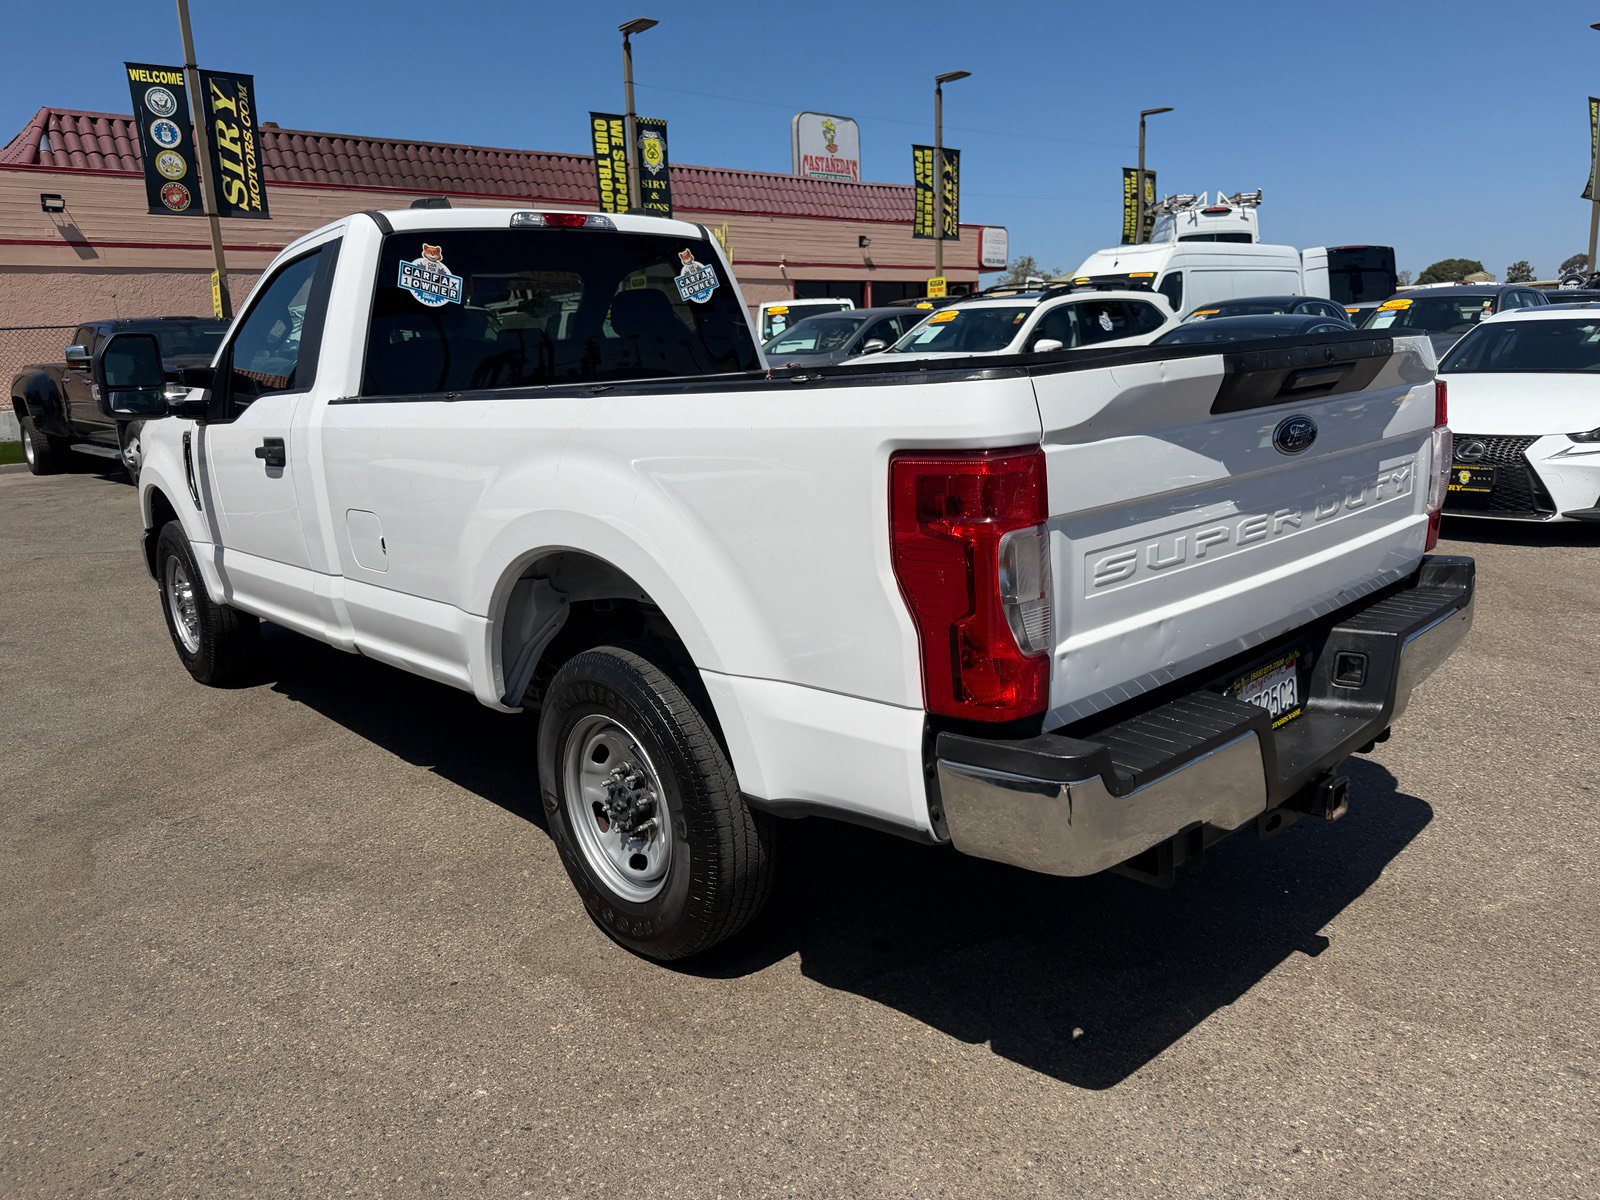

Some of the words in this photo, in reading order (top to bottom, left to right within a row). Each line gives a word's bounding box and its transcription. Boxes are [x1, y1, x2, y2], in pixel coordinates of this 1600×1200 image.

[128, 68, 184, 86] WELCOME
[208, 77, 249, 212] SIRY
[237, 81, 262, 211] MOTORS.COM
[593, 119, 609, 154] OUR
[609, 119, 624, 146] WE
[597, 157, 614, 213] TROOP
[612, 149, 628, 214] SUPPOR
[642, 179, 668, 190] SIRY
[914, 150, 924, 185] PAY
[924, 149, 933, 187] BUY
[643, 202, 670, 213] SONS
[650, 191, 660, 200] &
[915, 187, 924, 234] HERE
[924, 190, 933, 236] HERE
[404, 267, 458, 289] CARFAX
[412, 280, 457, 299] OWNER
[680, 270, 714, 287] CARFAX
[688, 278, 716, 294] OWNER
[1094, 508, 1302, 587] SUPER
[1314, 467, 1410, 522] DUTY
[1245, 677, 1296, 717] 725C3
